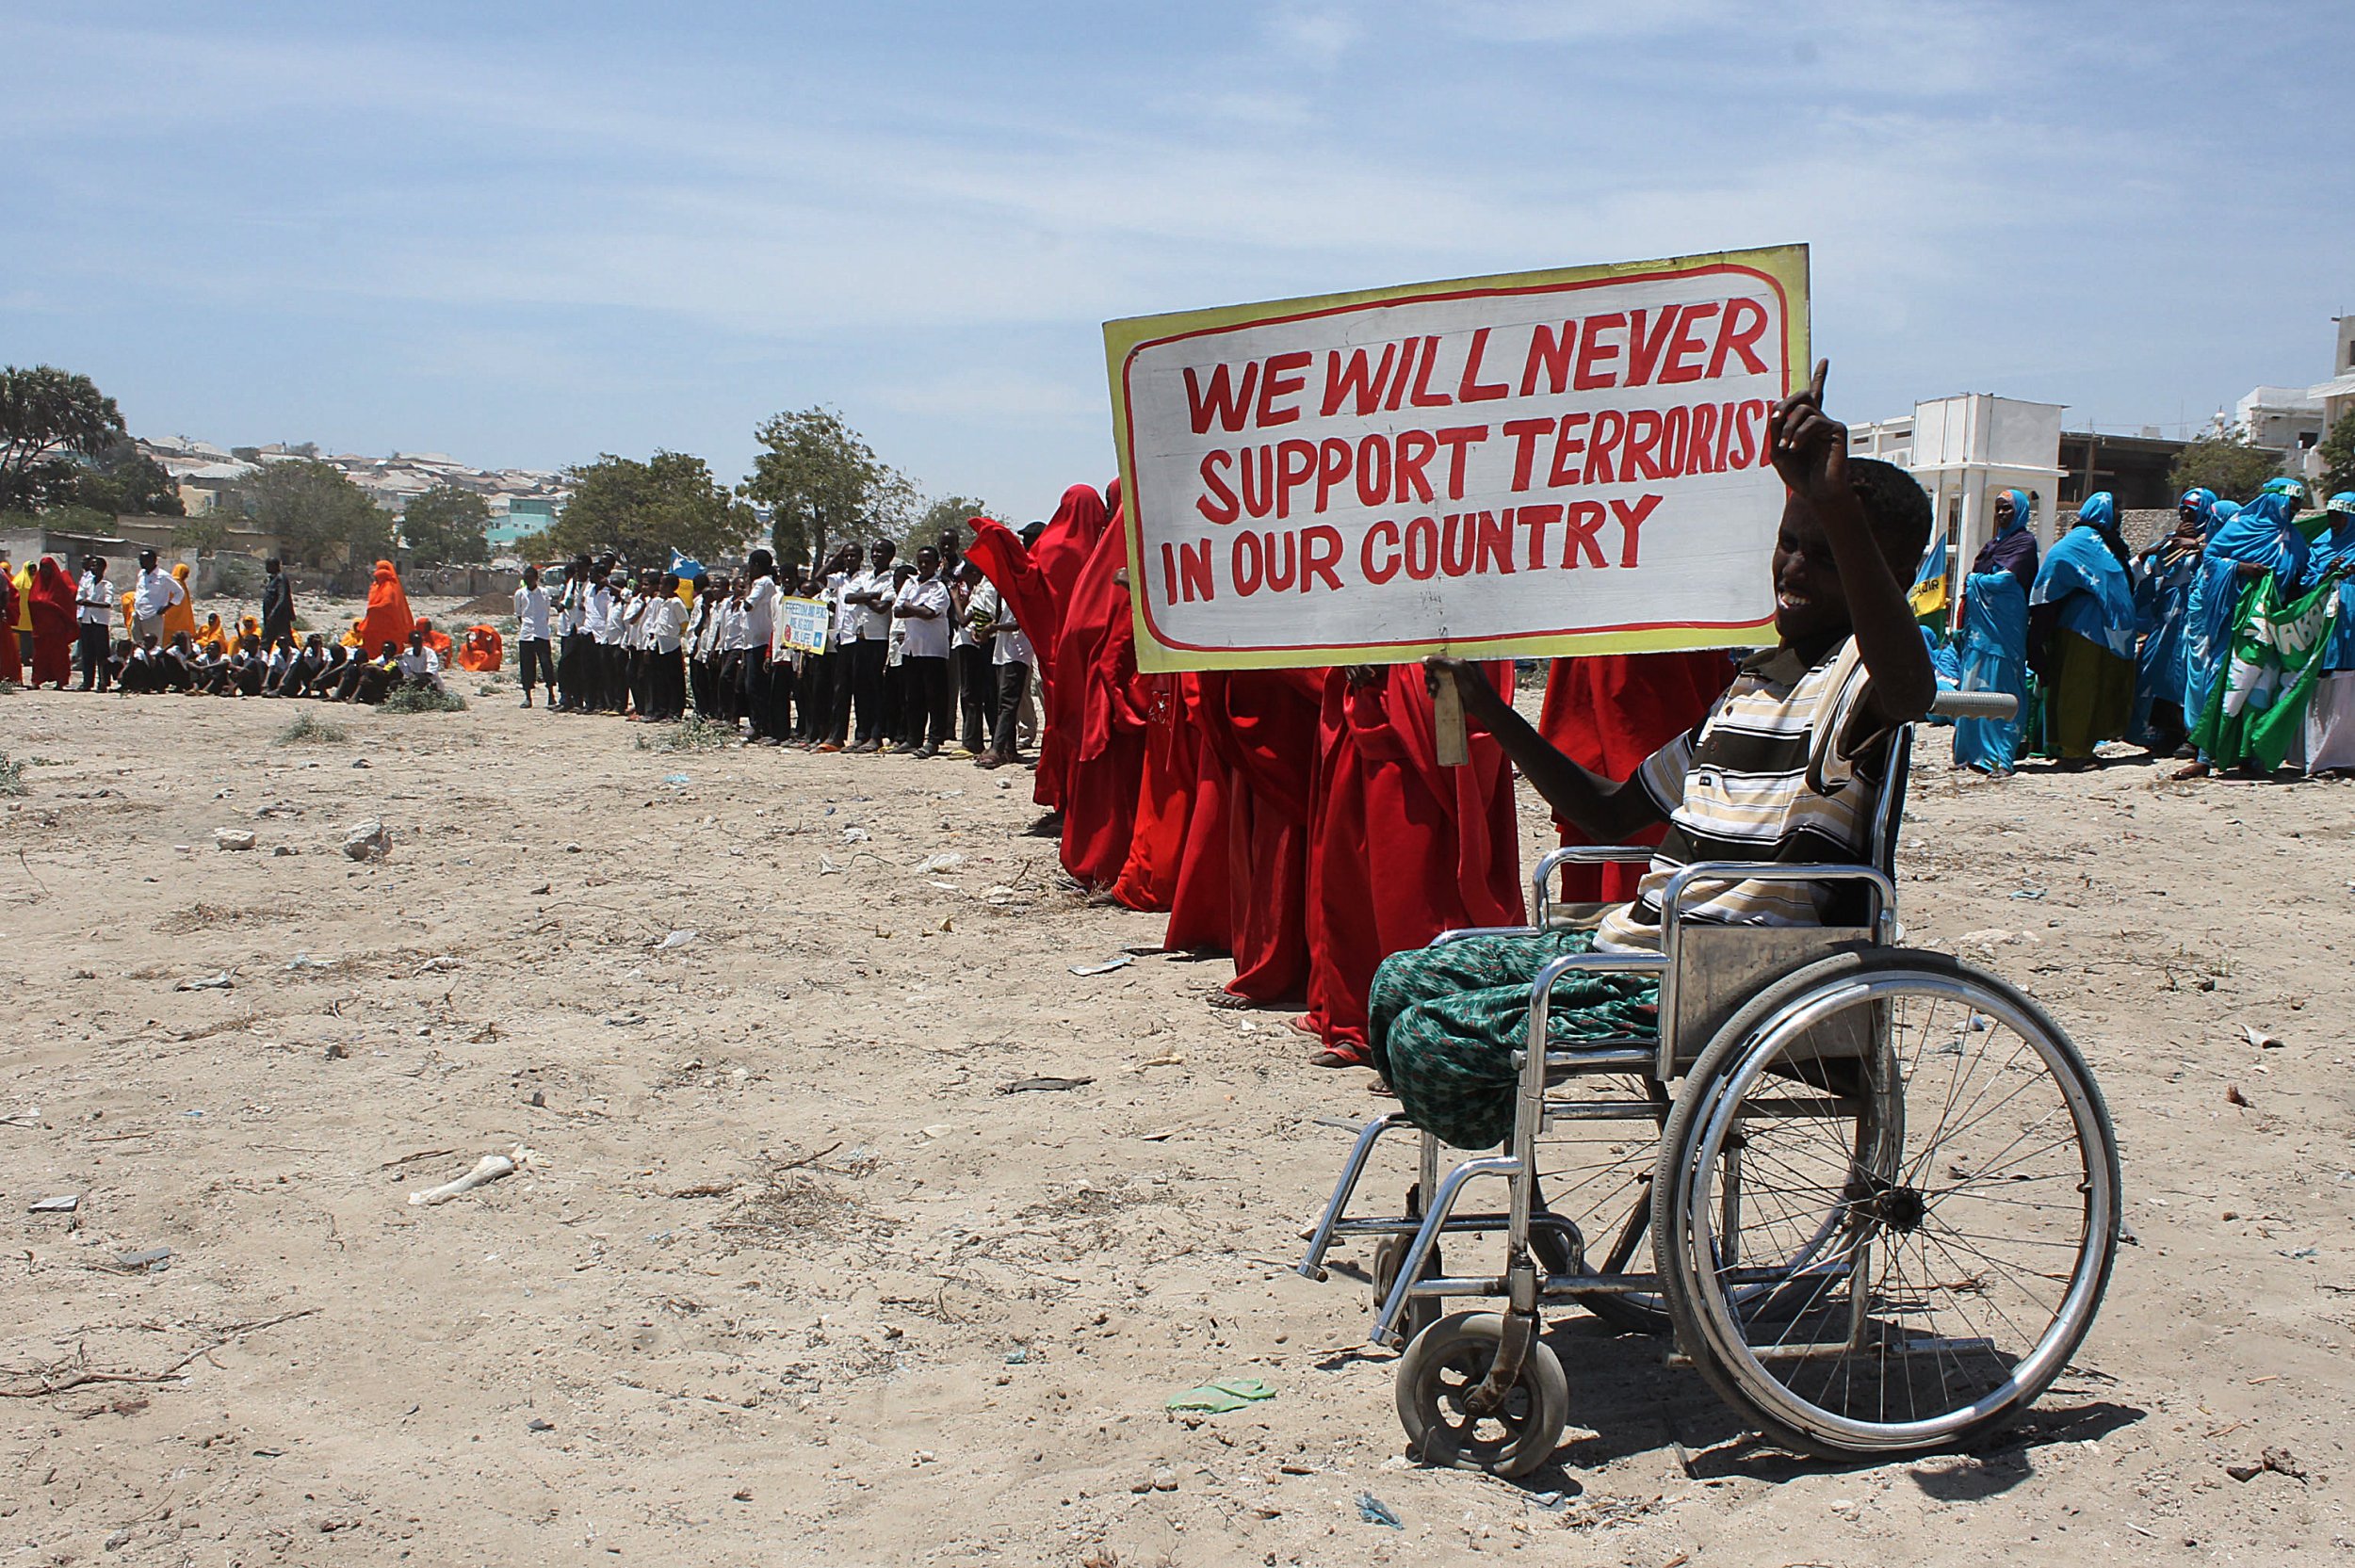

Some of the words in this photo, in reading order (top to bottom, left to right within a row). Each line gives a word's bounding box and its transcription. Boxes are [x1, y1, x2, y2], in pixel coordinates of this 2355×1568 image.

[1183, 351, 1312, 434] WE
[1320, 328, 1509, 416] WILL
[1520, 298, 1768, 396] NEVER
[1196, 425, 1488, 525] SUPPORT
[1161, 538, 1214, 606] IN
[1231, 525, 1344, 597] OUR
[1360, 495, 1663, 585] COUNTRY
